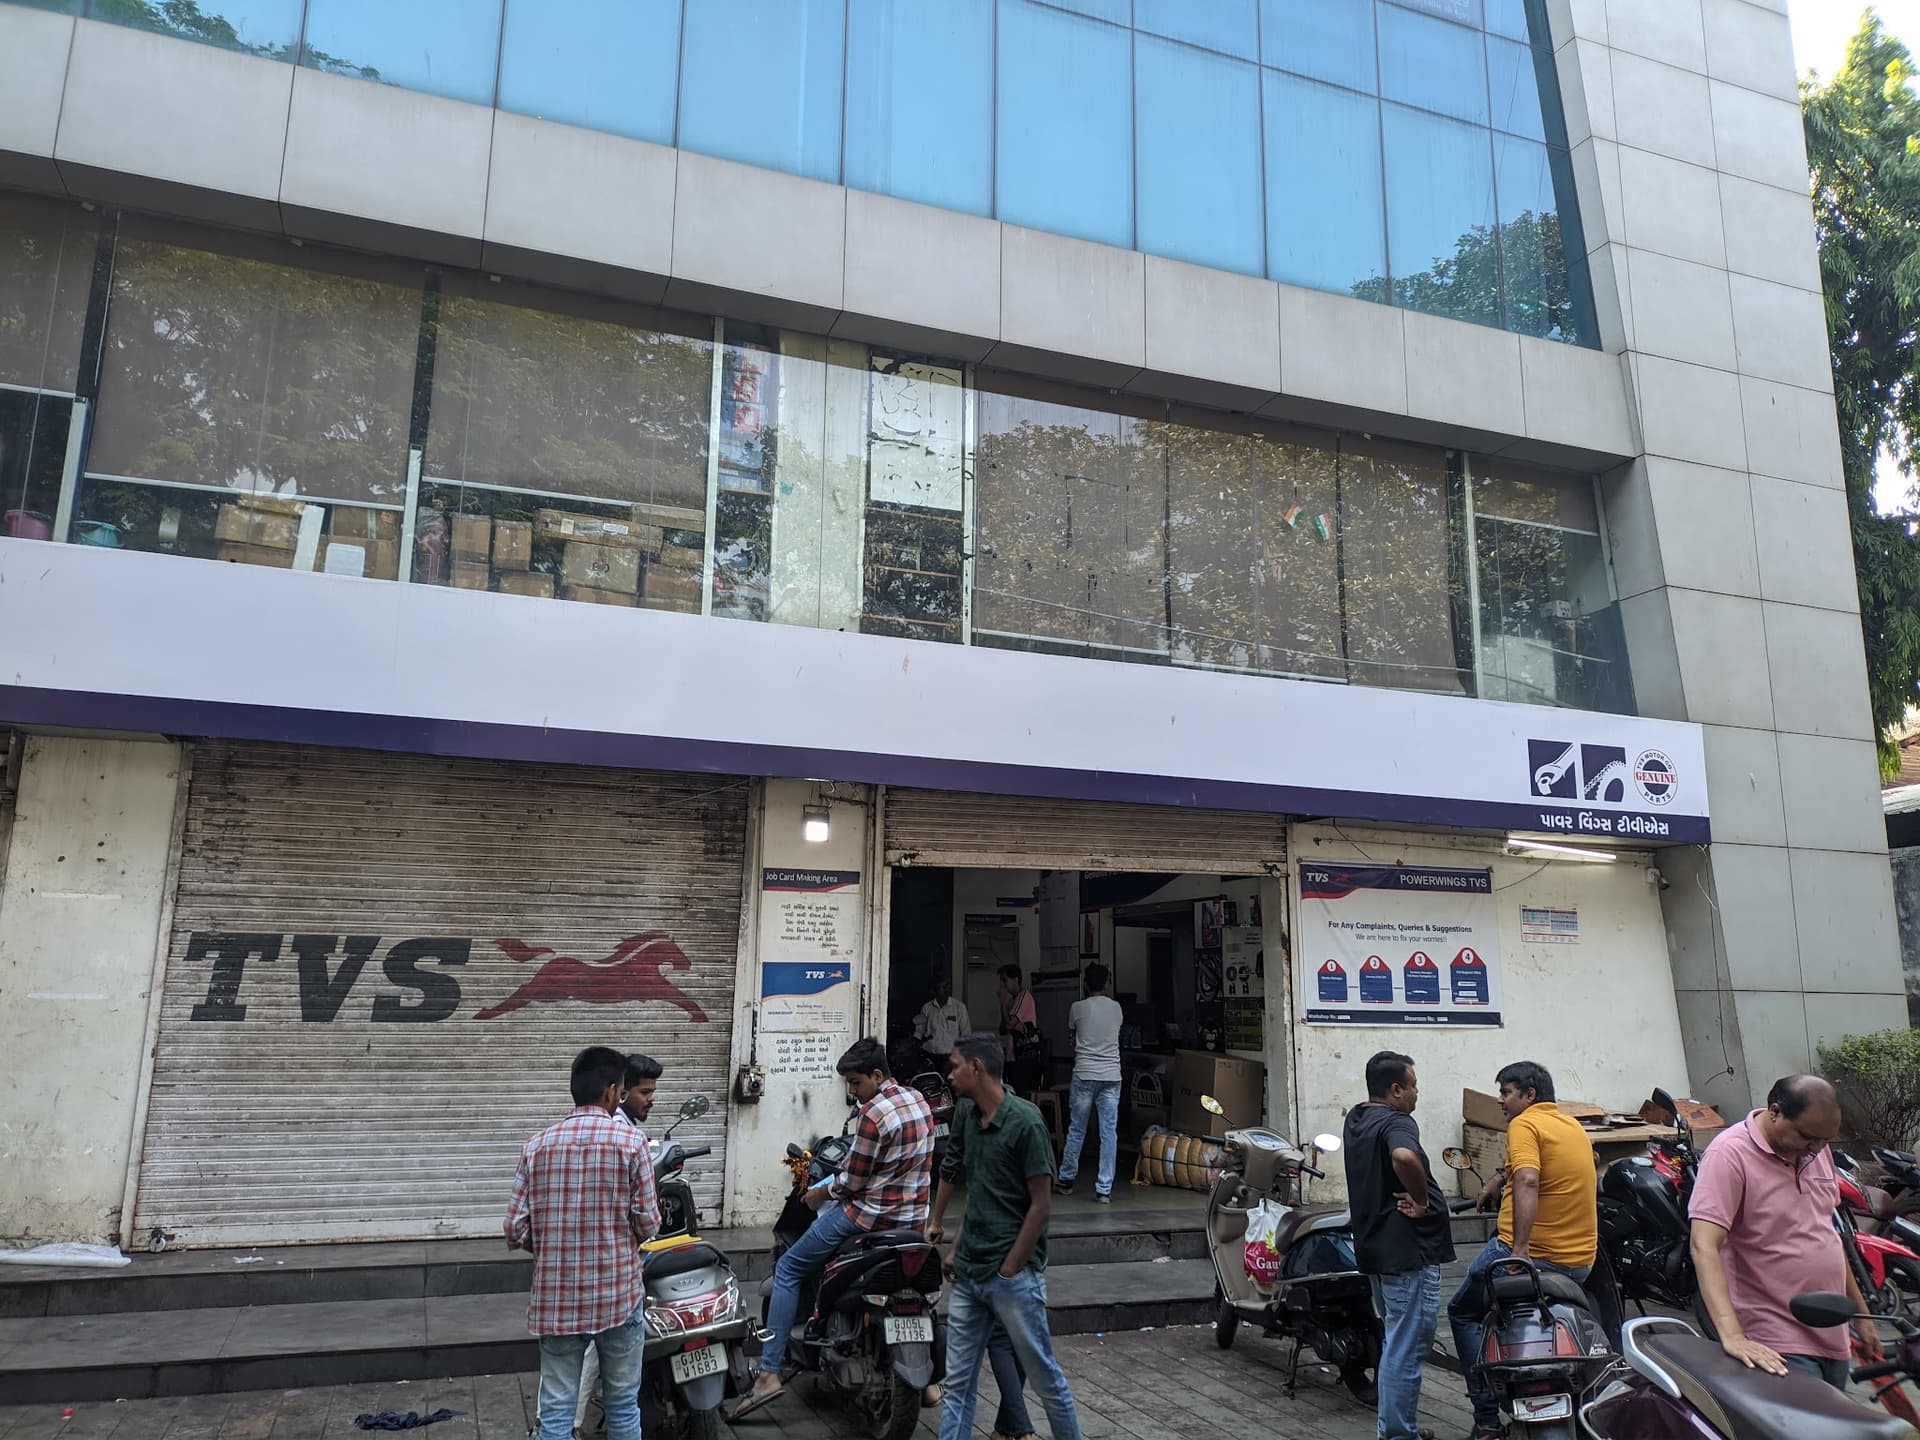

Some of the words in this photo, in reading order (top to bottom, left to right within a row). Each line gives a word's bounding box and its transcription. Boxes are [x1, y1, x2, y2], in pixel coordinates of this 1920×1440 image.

[1644, 752, 1665, 761] MOTOR
[1635, 771, 1677, 784] GENUINE
[1644, 791, 1672, 803] PARTS
[1540, 814, 1574, 829] પાવર
[1578, 811, 1612, 832] વિંગ્સ
[1617, 815, 1670, 835] ટીવીએસ
[779, 873, 794, 881] Card
[796, 873, 821, 884] Making
[822, 874, 838, 883] Area
[1306, 872, 1329, 883] TVS
[1399, 874, 1467, 887] POWERWINGS
[1469, 877, 1488, 888] TVS
[1340, 921, 1354, 930] Any
[1398, 923, 1424, 932] Queries
[1432, 925, 1473, 934] Suggestions
[1417, 956, 1422, 964] 3
[1465, 953, 1470, 961] 4
[185, 931, 472, 1023] TVS
[805, 970, 826, 979] TVS
[894, 1319, 927, 1330] GJ05L
[895, 1330, 926, 1342] Z1136
[680, 1347, 716, 1367] GJ05L
[683, 1359, 718, 1379] W1683
